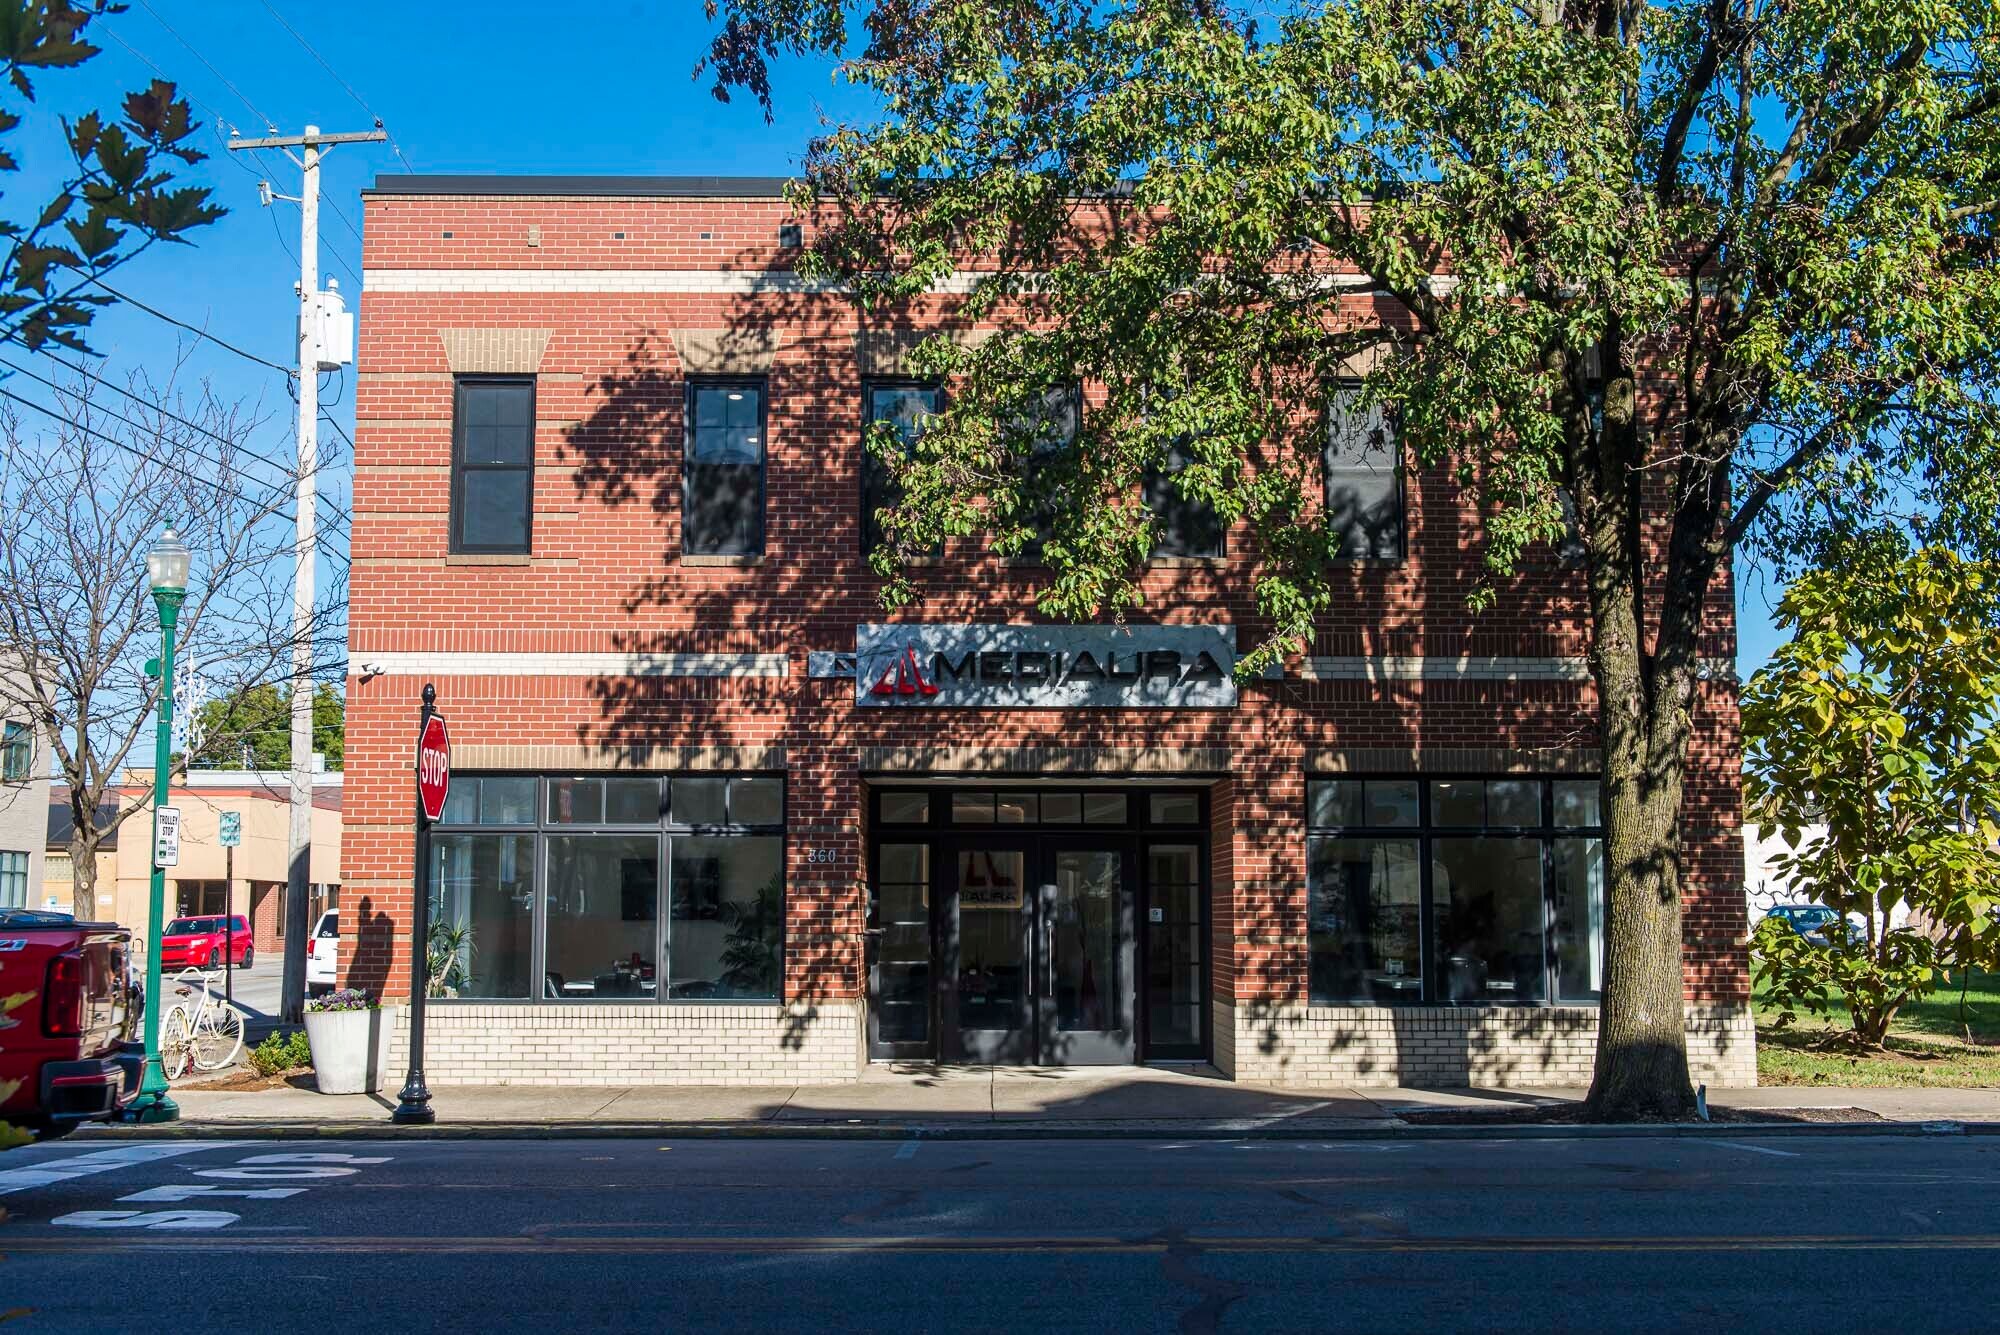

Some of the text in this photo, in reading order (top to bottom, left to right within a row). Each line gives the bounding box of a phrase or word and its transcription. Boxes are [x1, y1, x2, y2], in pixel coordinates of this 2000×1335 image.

[933, 649, 1226, 682] MEDIAURA
[421, 747, 448, 787] STOP
[159, 814, 178, 825] TROLLEY
[162, 826, 174, 836] STOP
[808, 848, 837, 863] 360
